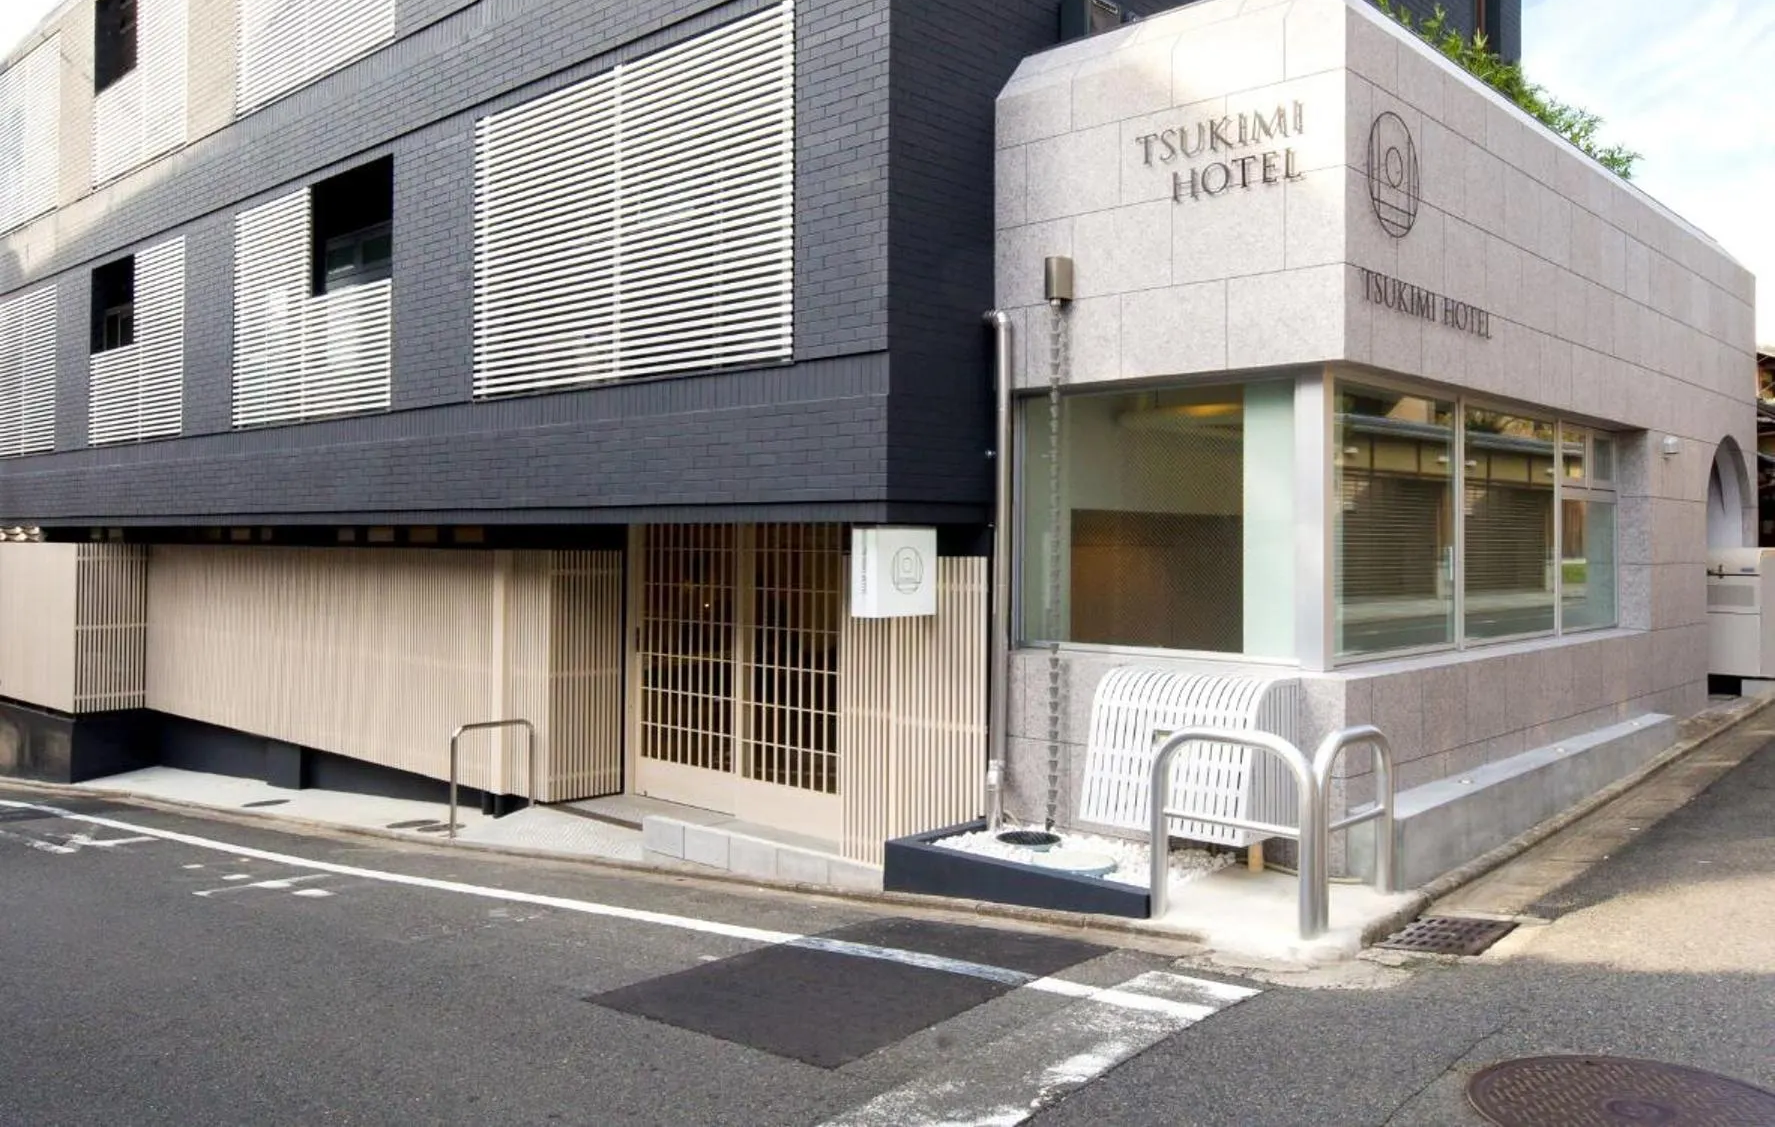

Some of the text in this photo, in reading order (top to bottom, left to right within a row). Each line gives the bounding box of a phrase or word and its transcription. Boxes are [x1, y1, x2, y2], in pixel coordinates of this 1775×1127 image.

[1135, 100, 1304, 166] TSUKIMI
[1172, 147, 1304, 203] HOTEL
[1361, 267, 1492, 340] TSUKIMI HOTEL
